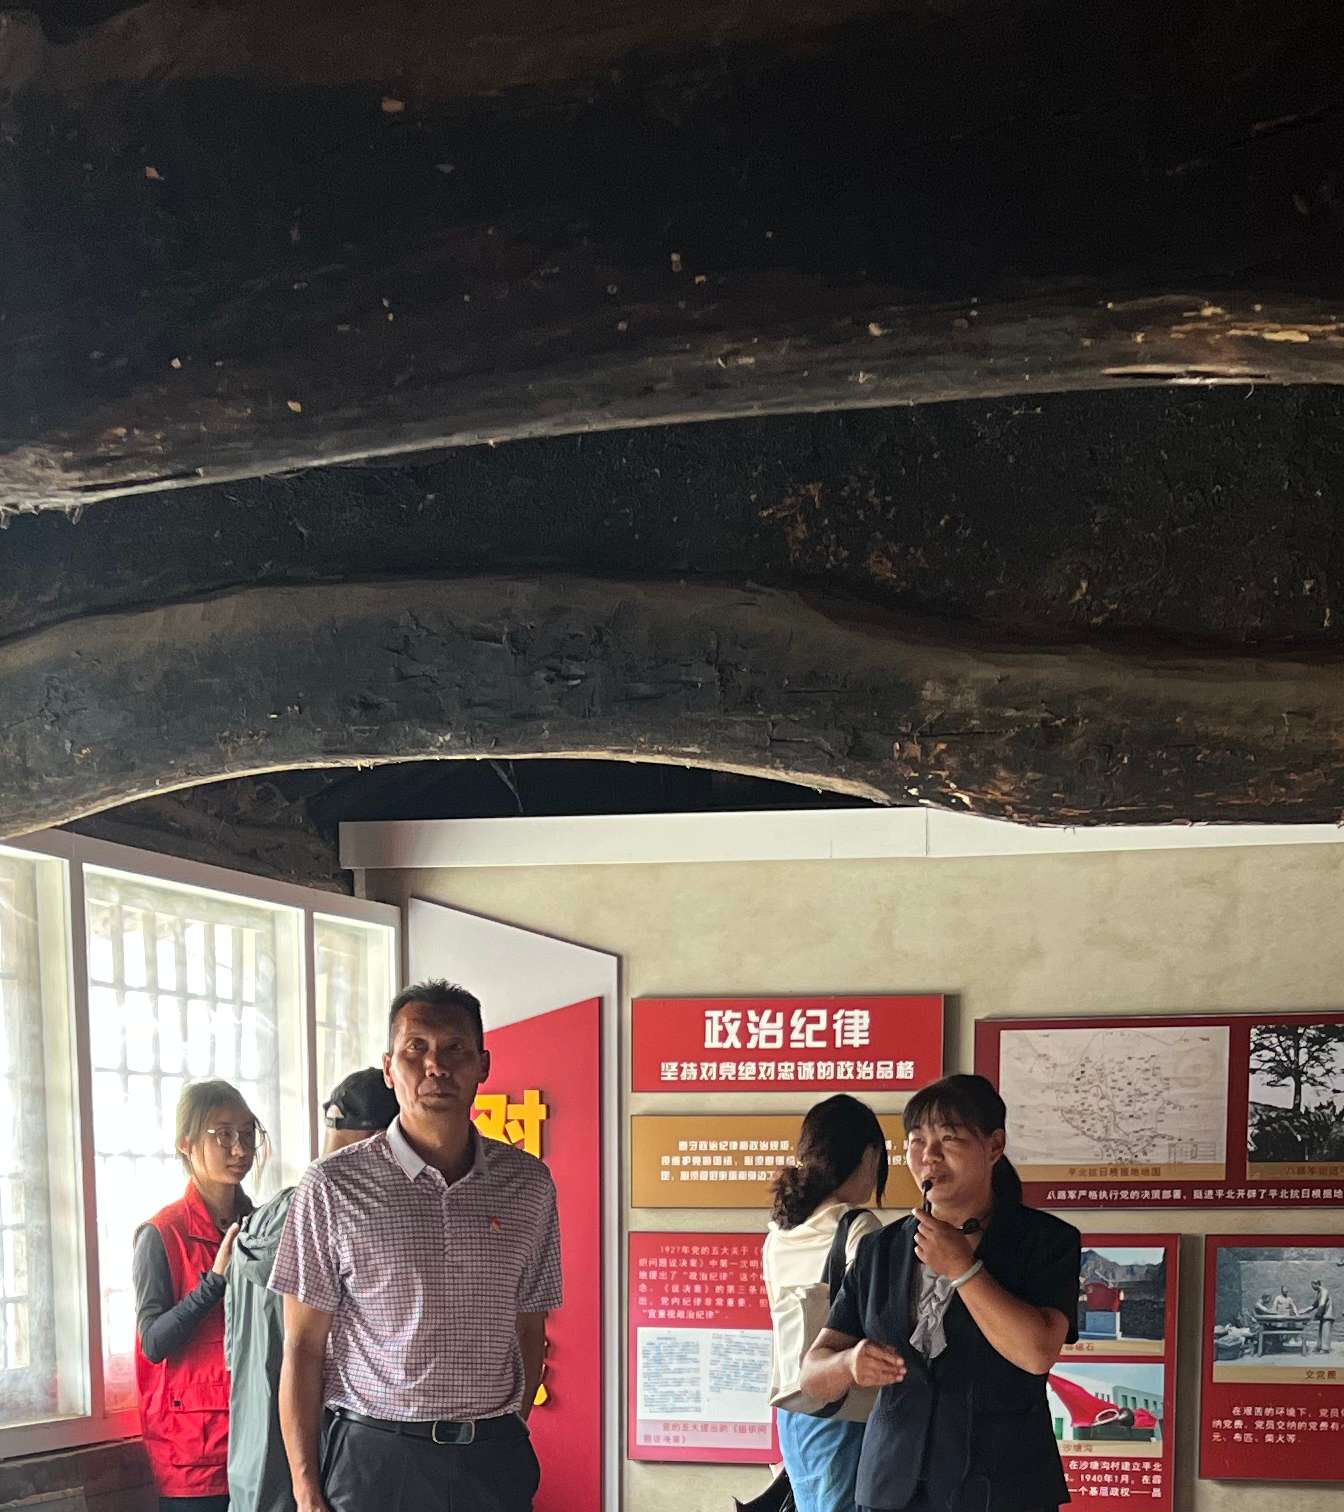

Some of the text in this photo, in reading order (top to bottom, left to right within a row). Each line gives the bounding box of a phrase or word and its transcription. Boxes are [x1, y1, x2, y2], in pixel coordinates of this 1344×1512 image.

[703, 1008, 872, 1049] 政治纪律
[660, 1060, 915, 1082] 坚持对党绝对忠诚的政治品格
[638, 1258, 764, 1269] 织问题议决案》中第一次明
